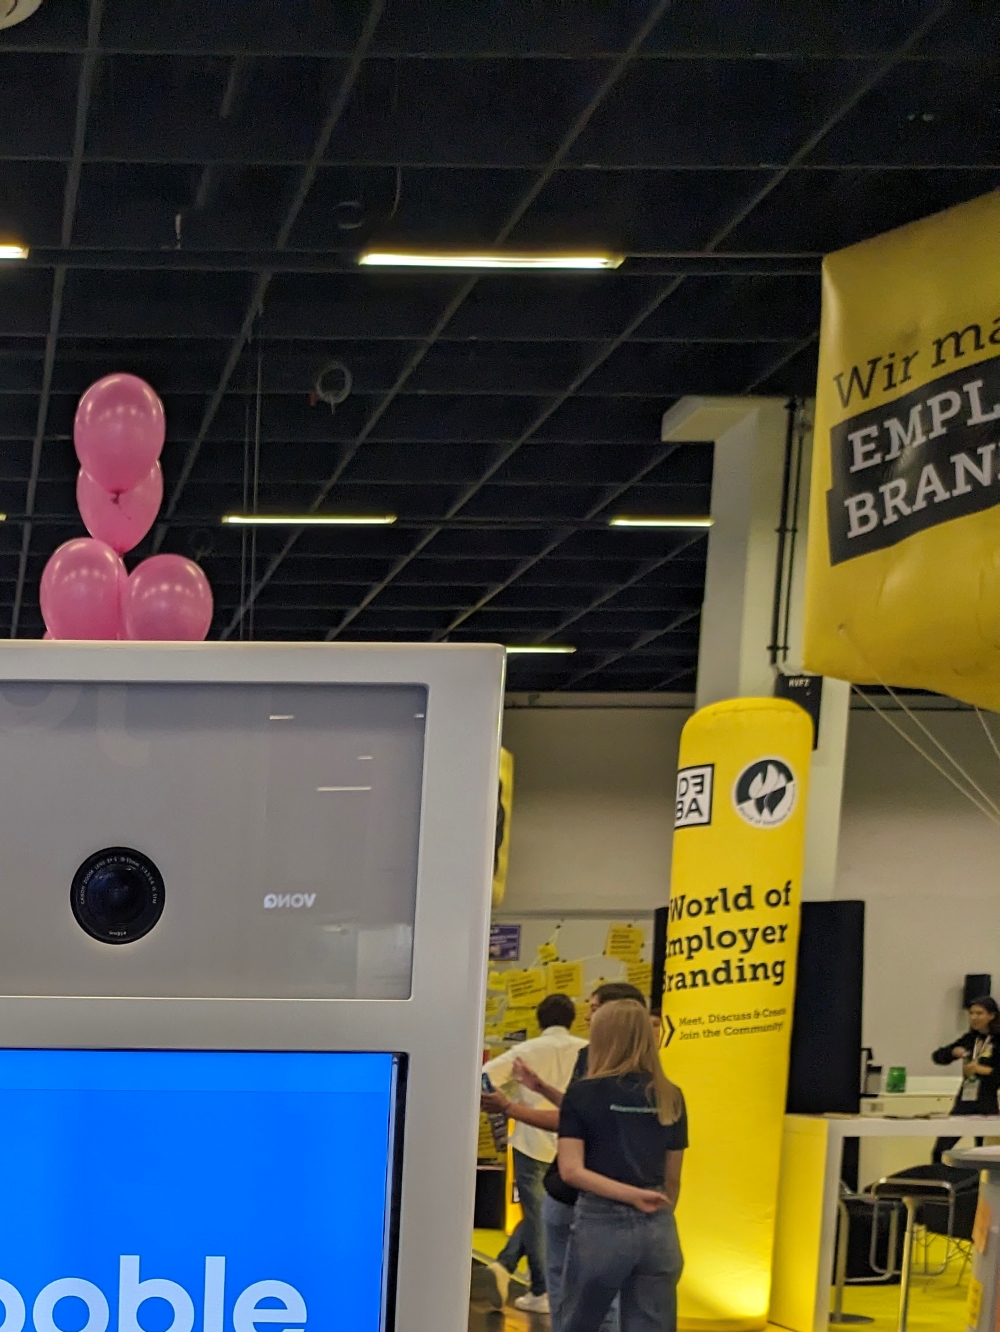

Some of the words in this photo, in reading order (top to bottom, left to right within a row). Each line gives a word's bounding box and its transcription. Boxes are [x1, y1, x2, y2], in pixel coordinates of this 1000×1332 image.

[833, 351, 919, 408] Wir
[844, 442, 1000, 539] BRAN
[670, 885, 755, 922] World
[764, 880, 792, 908] of
[666, 924, 788, 960] mployer
[679, 1031, 699, 1040] Join
[702, 1029, 720, 1038] the
[708, 1012, 751, 1023] Discuss
